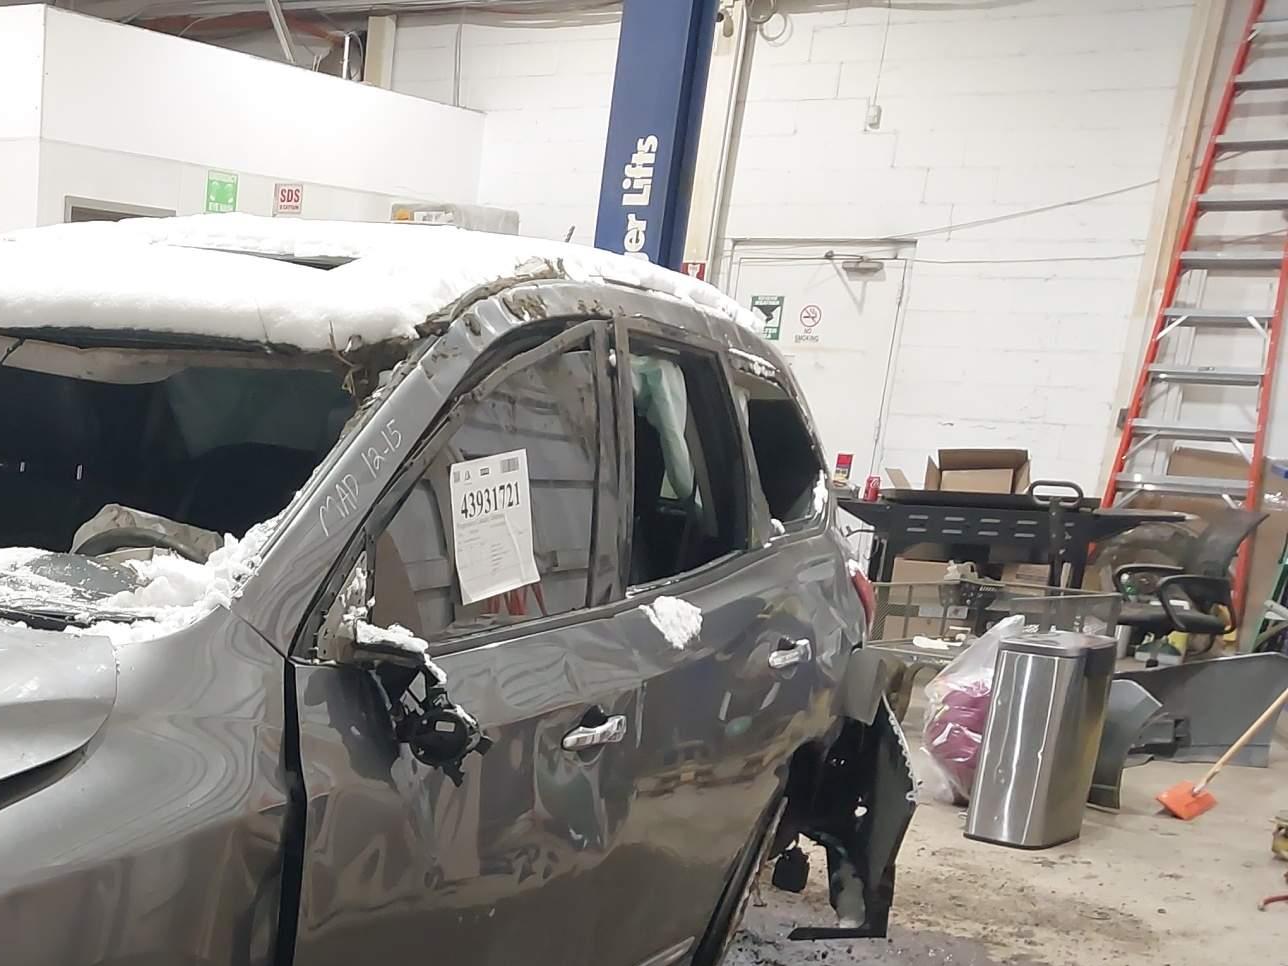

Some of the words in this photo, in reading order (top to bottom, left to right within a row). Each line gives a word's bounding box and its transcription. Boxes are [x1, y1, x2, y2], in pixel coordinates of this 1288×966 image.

[279, 188, 301, 203] SDS
[622, 134, 659, 206] Lifts
[319, 473, 359, 537] MAD
[360, 419, 402, 479] 12-15
[460, 481, 520, 519] 43931721
